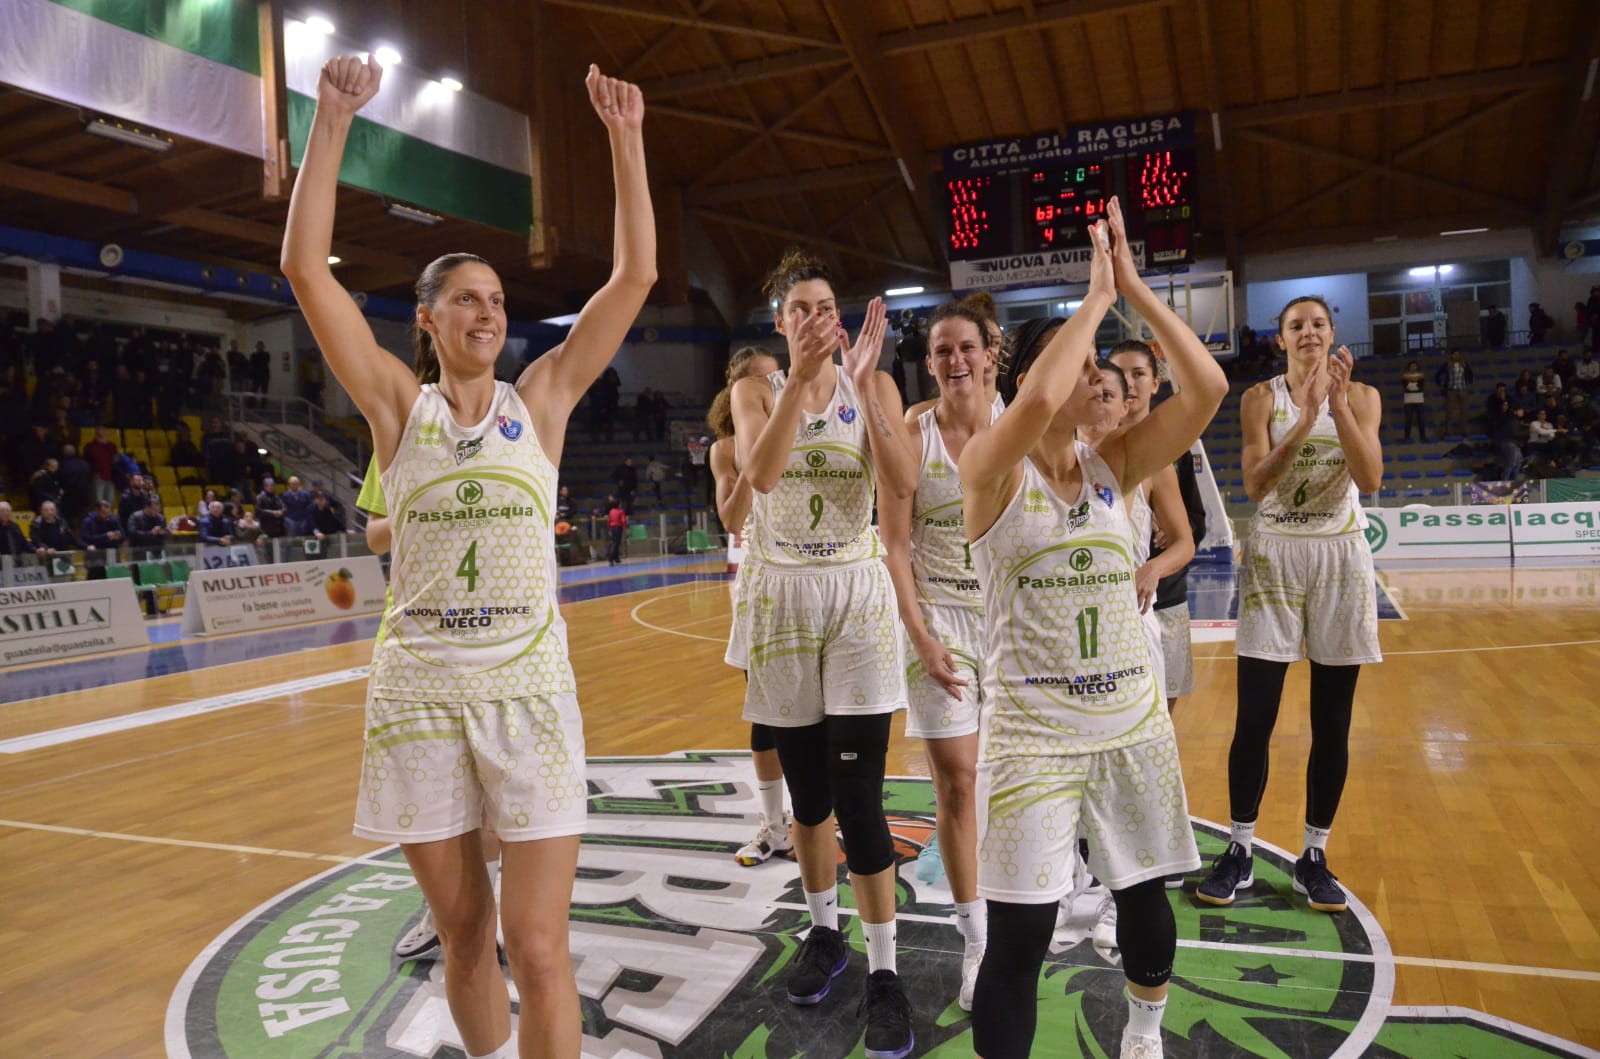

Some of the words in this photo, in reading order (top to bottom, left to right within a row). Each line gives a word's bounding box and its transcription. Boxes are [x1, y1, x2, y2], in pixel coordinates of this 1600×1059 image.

[1036, 134, 1060, 150] DI
[1077, 116, 1182, 143] RAGUSA
[970, 147, 1072, 168] Assessorato
[1078, 142, 1110, 154] allo
[1116, 133, 1164, 149] Sport
[1036, 205, 1054, 222] 63
[1086, 199, 1104, 215] 61
[1044, 227, 1054, 242] 4
[987, 255, 1044, 272] NUOVA
[1051, 251, 1092, 266] AVIR
[781, 469, 863, 479] ssalacqua
[1293, 478, 1309, 507] 6
[407, 506, 534, 523] Passalacqua
[809, 493, 824, 531] 9
[1400, 510, 1600, 528] Passalacq
[456, 540, 479, 592] 4
[203, 572, 301, 592] MULTIFIDI
[1017, 570, 1132, 589] Passalacqua
[253, 600, 278, 611] bene
[404, 608, 442, 617] NUOVA
[445, 607, 475, 617] AVIR
[479, 606, 530, 616] SERVICE
[438, 616, 492, 629] IVECO
[1074, 606, 1098, 660] 17
[1025, 675, 1071, 685] NUOVA
[1073, 673, 1102, 684] AVIR
[1106, 665, 1146, 681] SERVICE
[1068, 681, 1118, 695] IVECO
[255, 871, 417, 1039] RAGUSA
